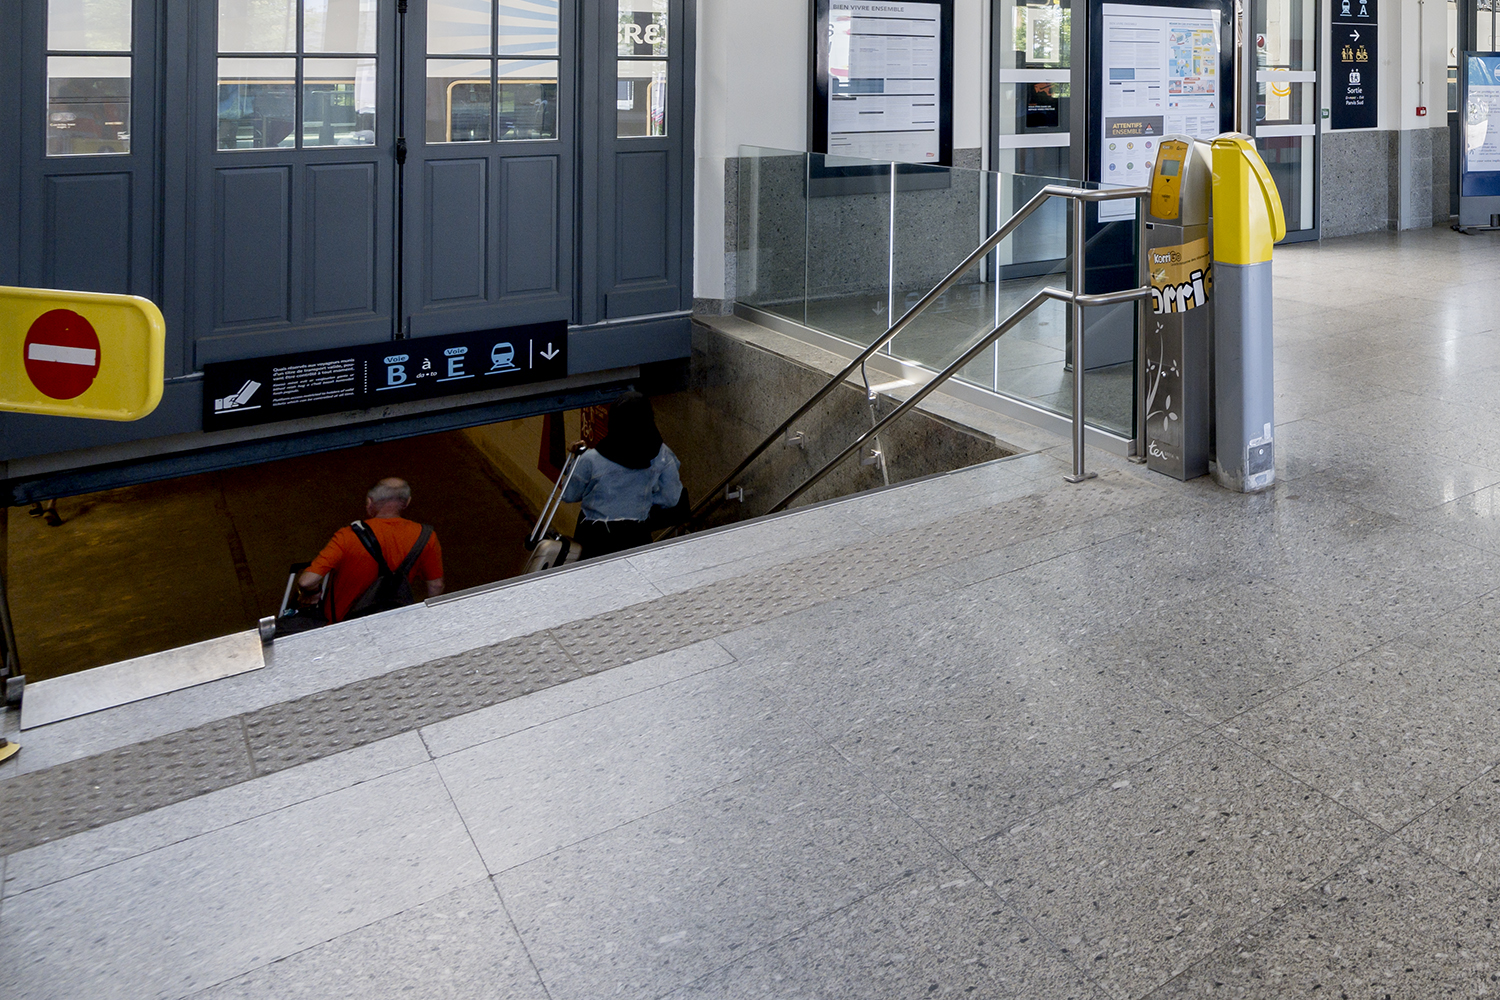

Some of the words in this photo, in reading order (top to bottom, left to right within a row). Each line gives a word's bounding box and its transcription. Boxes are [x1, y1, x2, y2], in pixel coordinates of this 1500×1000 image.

[851, 4, 869, 12] VIVRE
[871, 5, 905, 13] ENSEMBLE
[1360, 5, 1367, 15] A
[1153, 251, 1182, 264] KorriGo
[387, 364, 407, 385] B
[422, 358, 431, 370] à
[448, 356, 465, 377] E
[1148, 439, 1168, 460] ter
